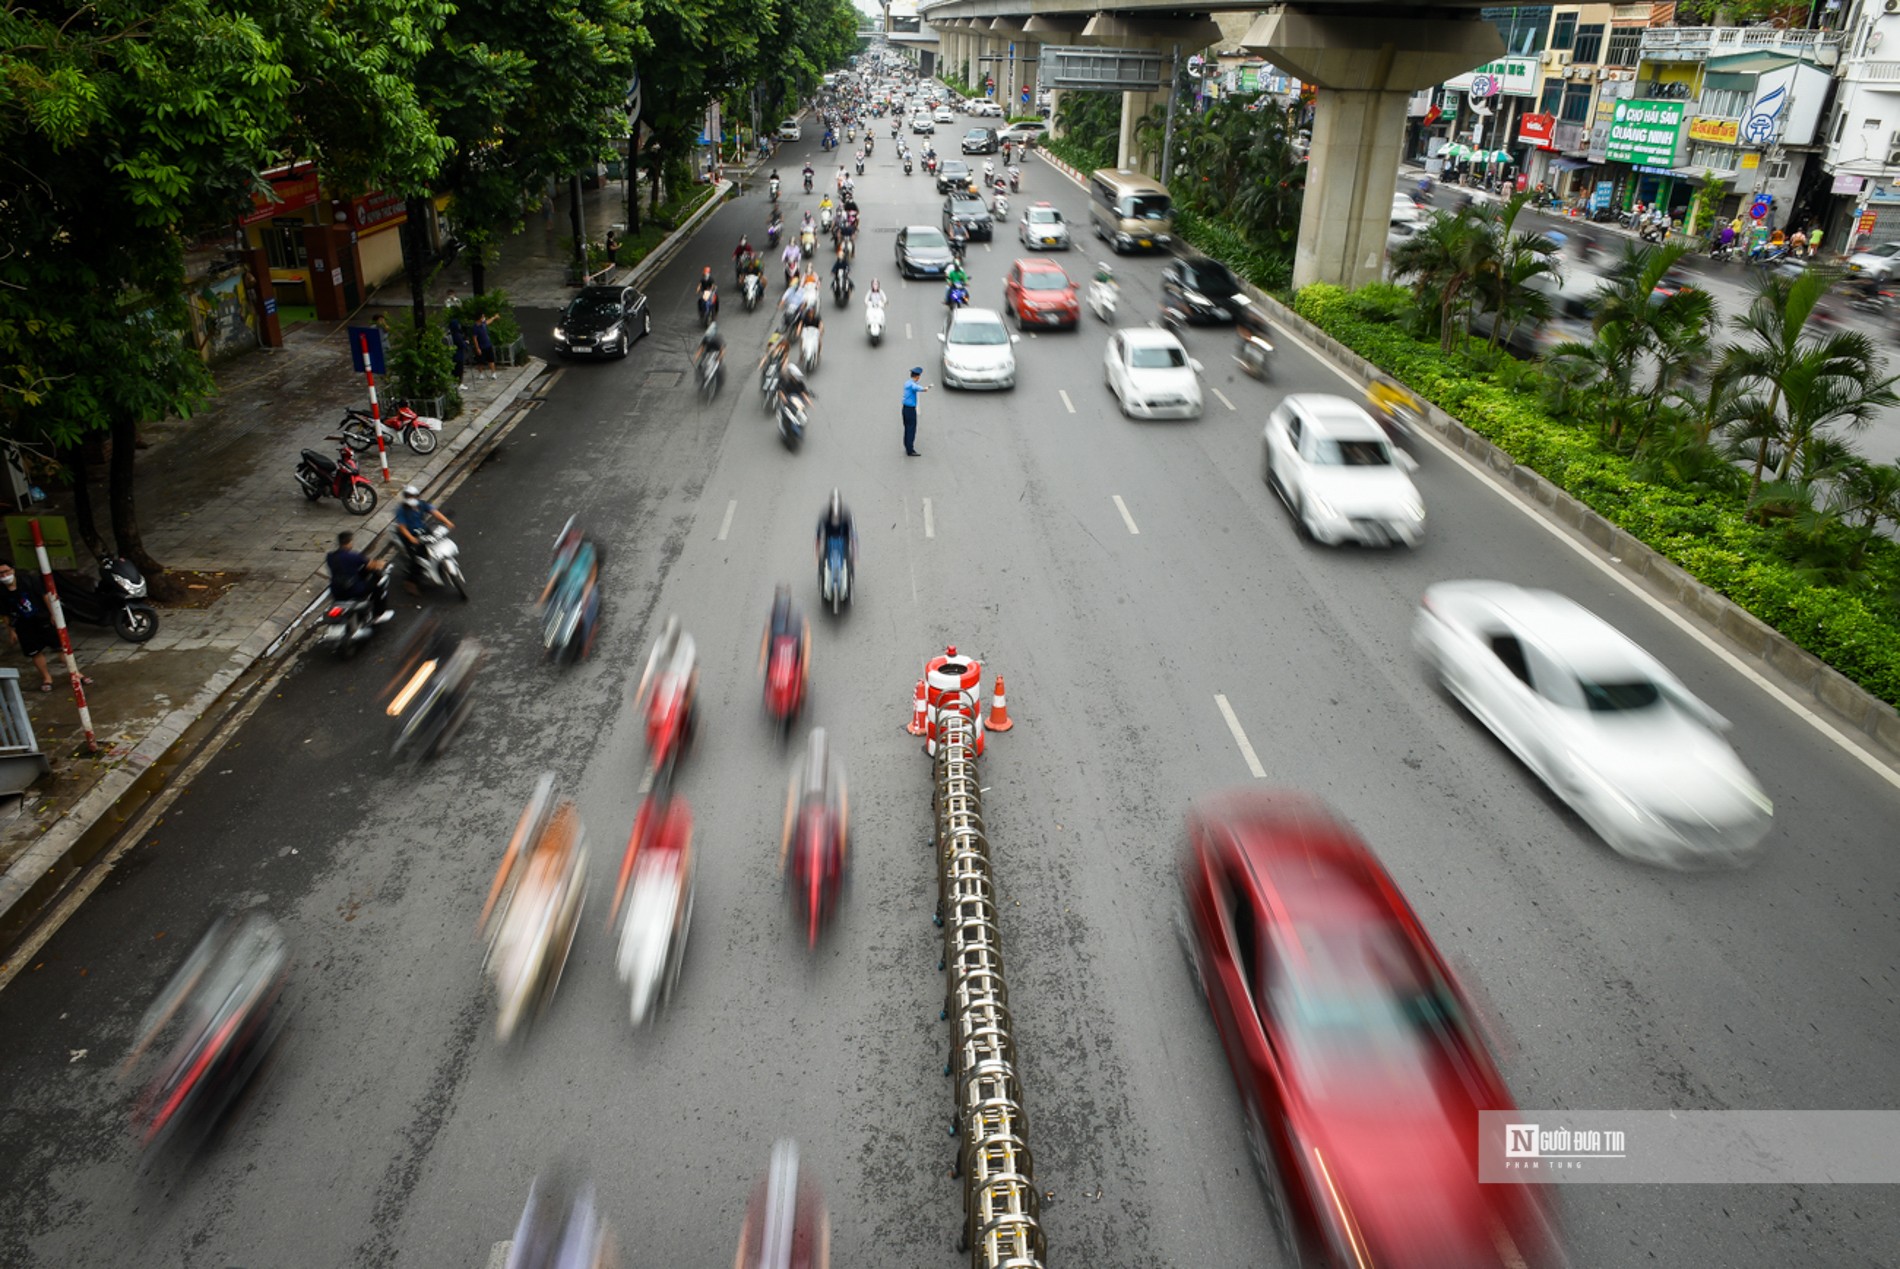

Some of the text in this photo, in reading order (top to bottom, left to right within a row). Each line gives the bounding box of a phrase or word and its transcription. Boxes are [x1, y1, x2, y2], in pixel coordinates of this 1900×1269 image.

[1626, 108, 1645, 125] CHỢ
[1643, 105, 1659, 123] HẢI
[1659, 106, 1679, 125] SẢN
[1611, 123, 1648, 143] QUẢNG
[1647, 130, 1674, 145] NINH
